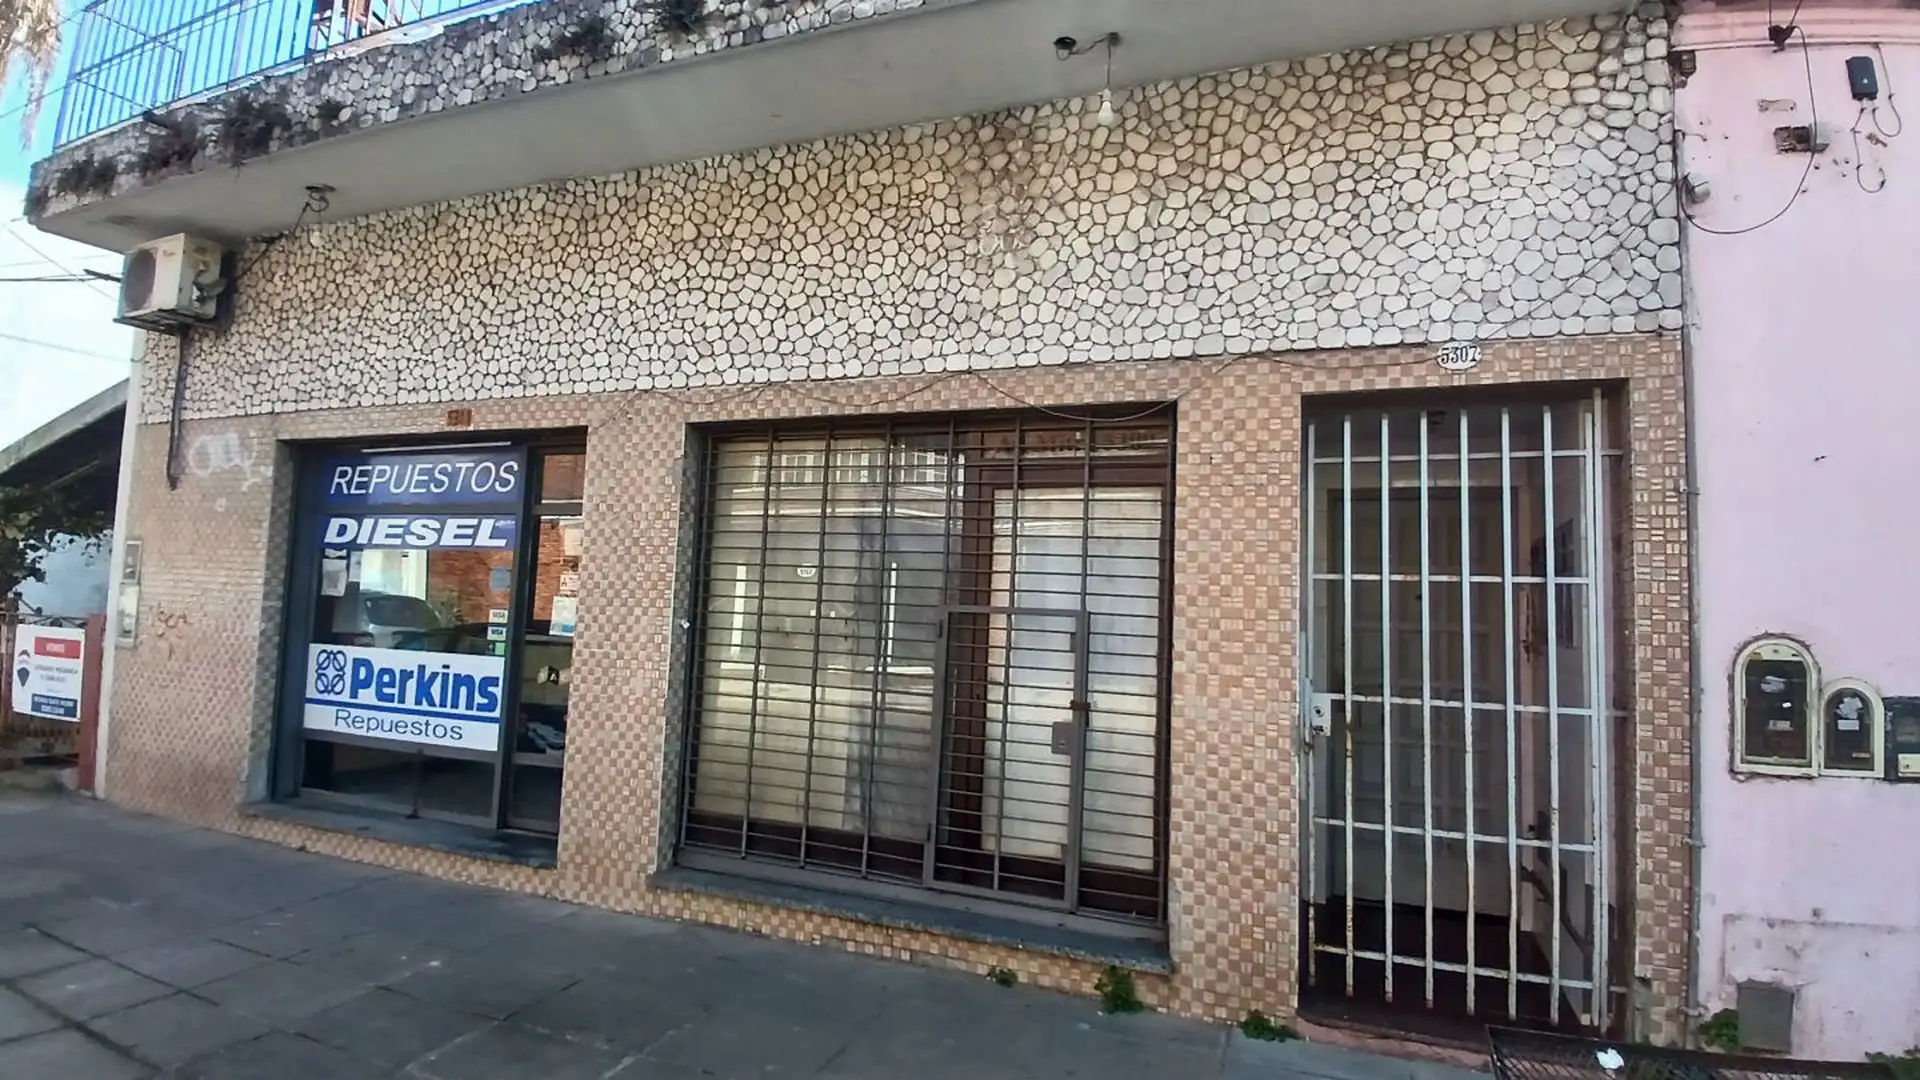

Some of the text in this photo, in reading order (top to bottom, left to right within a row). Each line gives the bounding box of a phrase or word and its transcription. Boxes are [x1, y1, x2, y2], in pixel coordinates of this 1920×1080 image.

[1440, 345, 1478, 365] 5307
[330, 460, 519, 495] REPUESTOS
[323, 517, 507, 548] DIESEL
[349, 657, 500, 713] Perkins
[334, 709, 463, 741] Repuestos
